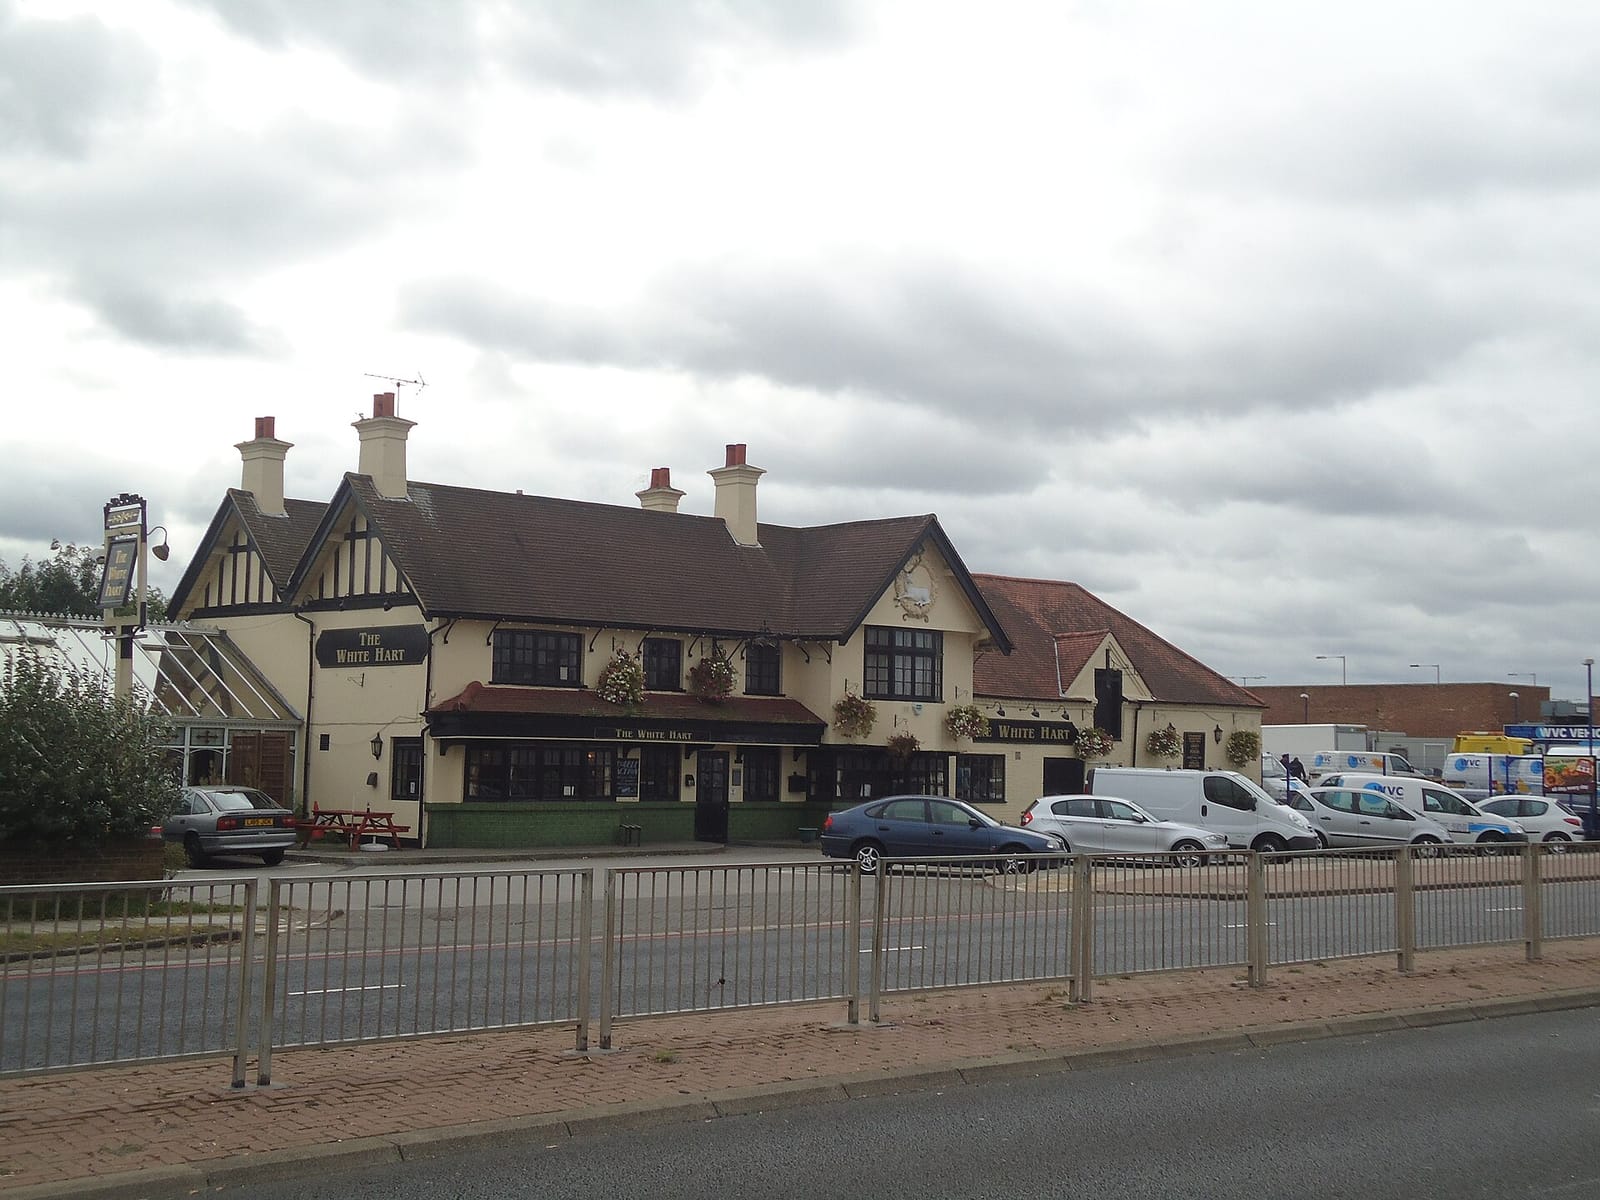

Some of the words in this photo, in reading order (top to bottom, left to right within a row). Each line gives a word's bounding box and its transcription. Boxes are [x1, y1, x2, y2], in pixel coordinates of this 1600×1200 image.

[115, 550, 128, 564] THE
[104, 583, 123, 597] HART
[359, 632, 381, 646] THE
[336, 649, 370, 663] WHITE
[374, 647, 406, 662] HART
[615, 728, 633, 738] THE
[637, 729, 665, 739] WHITE
[669, 730, 693, 740] HART
[998, 724, 1035, 739] WHITE
[1040, 726, 1071, 740] HART
[1541, 727, 1568, 738] WVC
[1461, 759, 1481, 767] WVC
[1374, 785, 1404, 796] WVC
